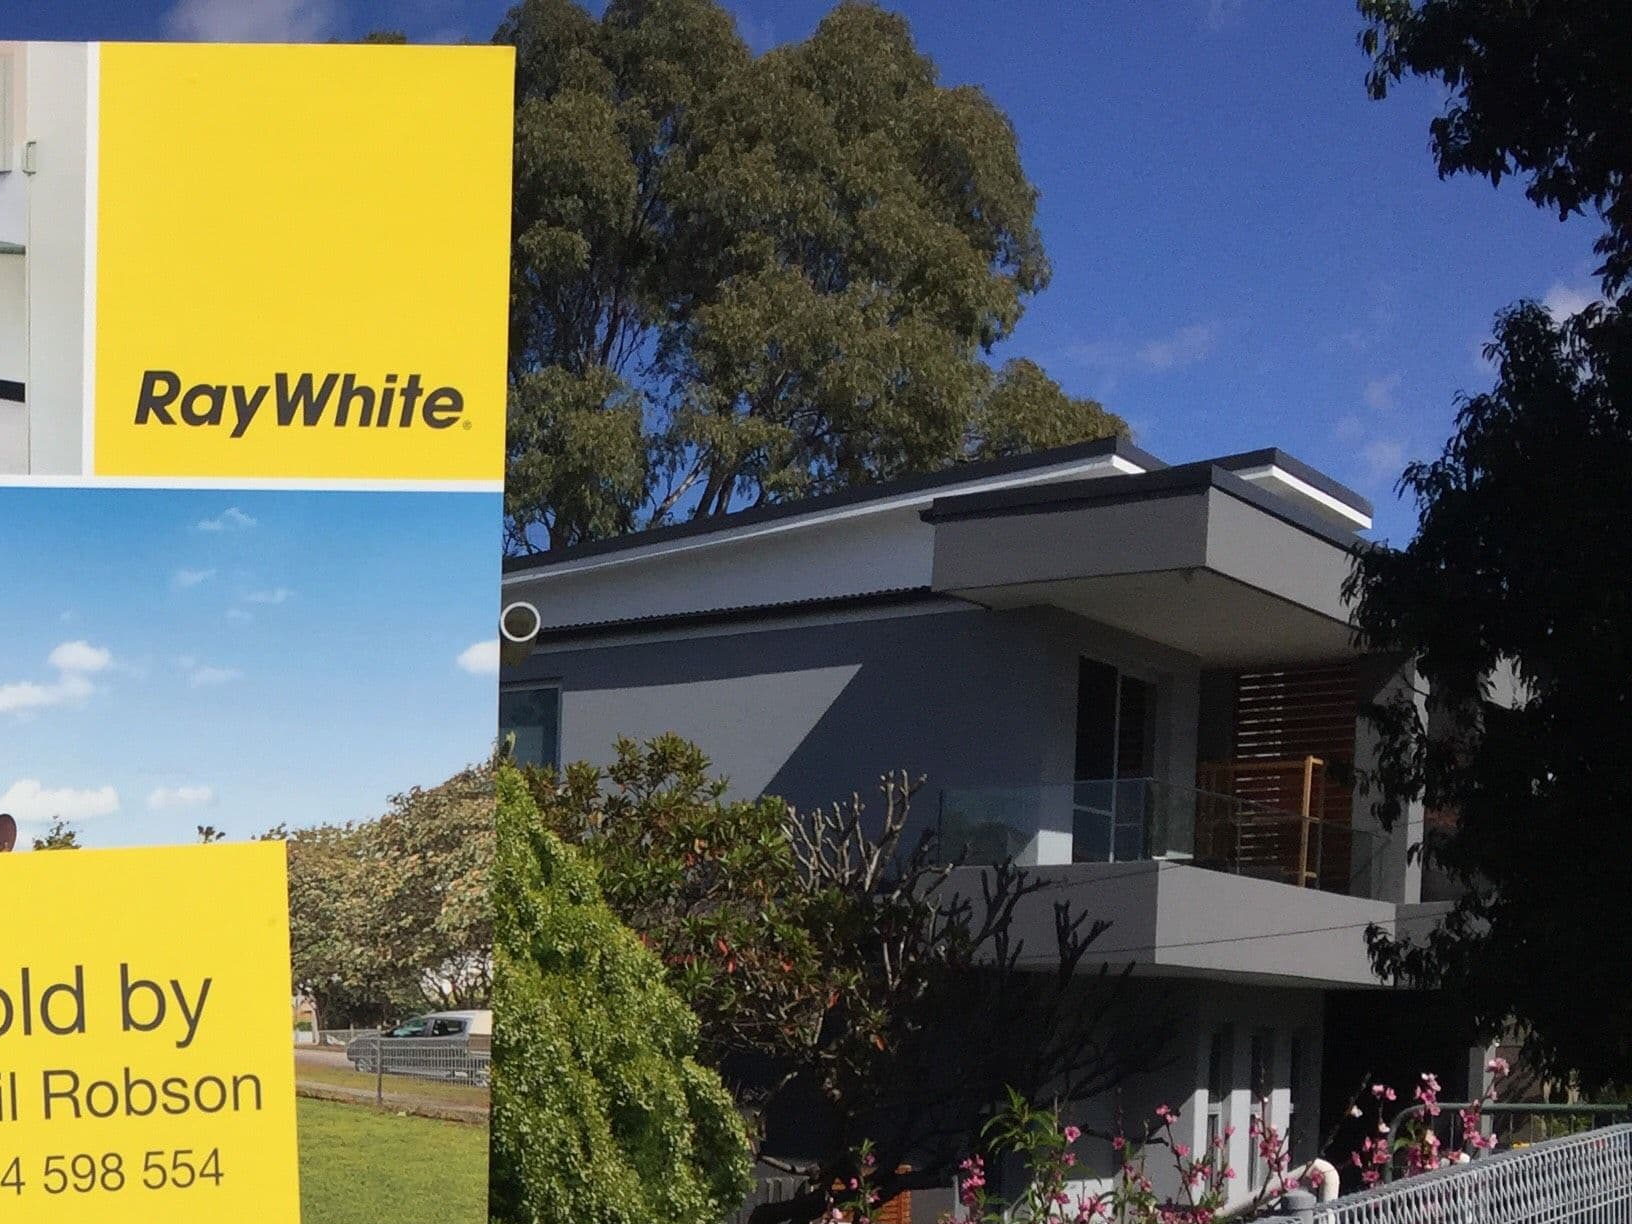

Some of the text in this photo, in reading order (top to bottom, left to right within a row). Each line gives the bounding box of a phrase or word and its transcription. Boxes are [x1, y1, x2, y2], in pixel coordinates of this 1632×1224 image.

[133, 369, 465, 439] RayWhite
[119, 962, 213, 1050] by
[42, 1066, 262, 1121] Robson
[43, 1152, 126, 1195] 598
[142, 1147, 225, 1190] 554
